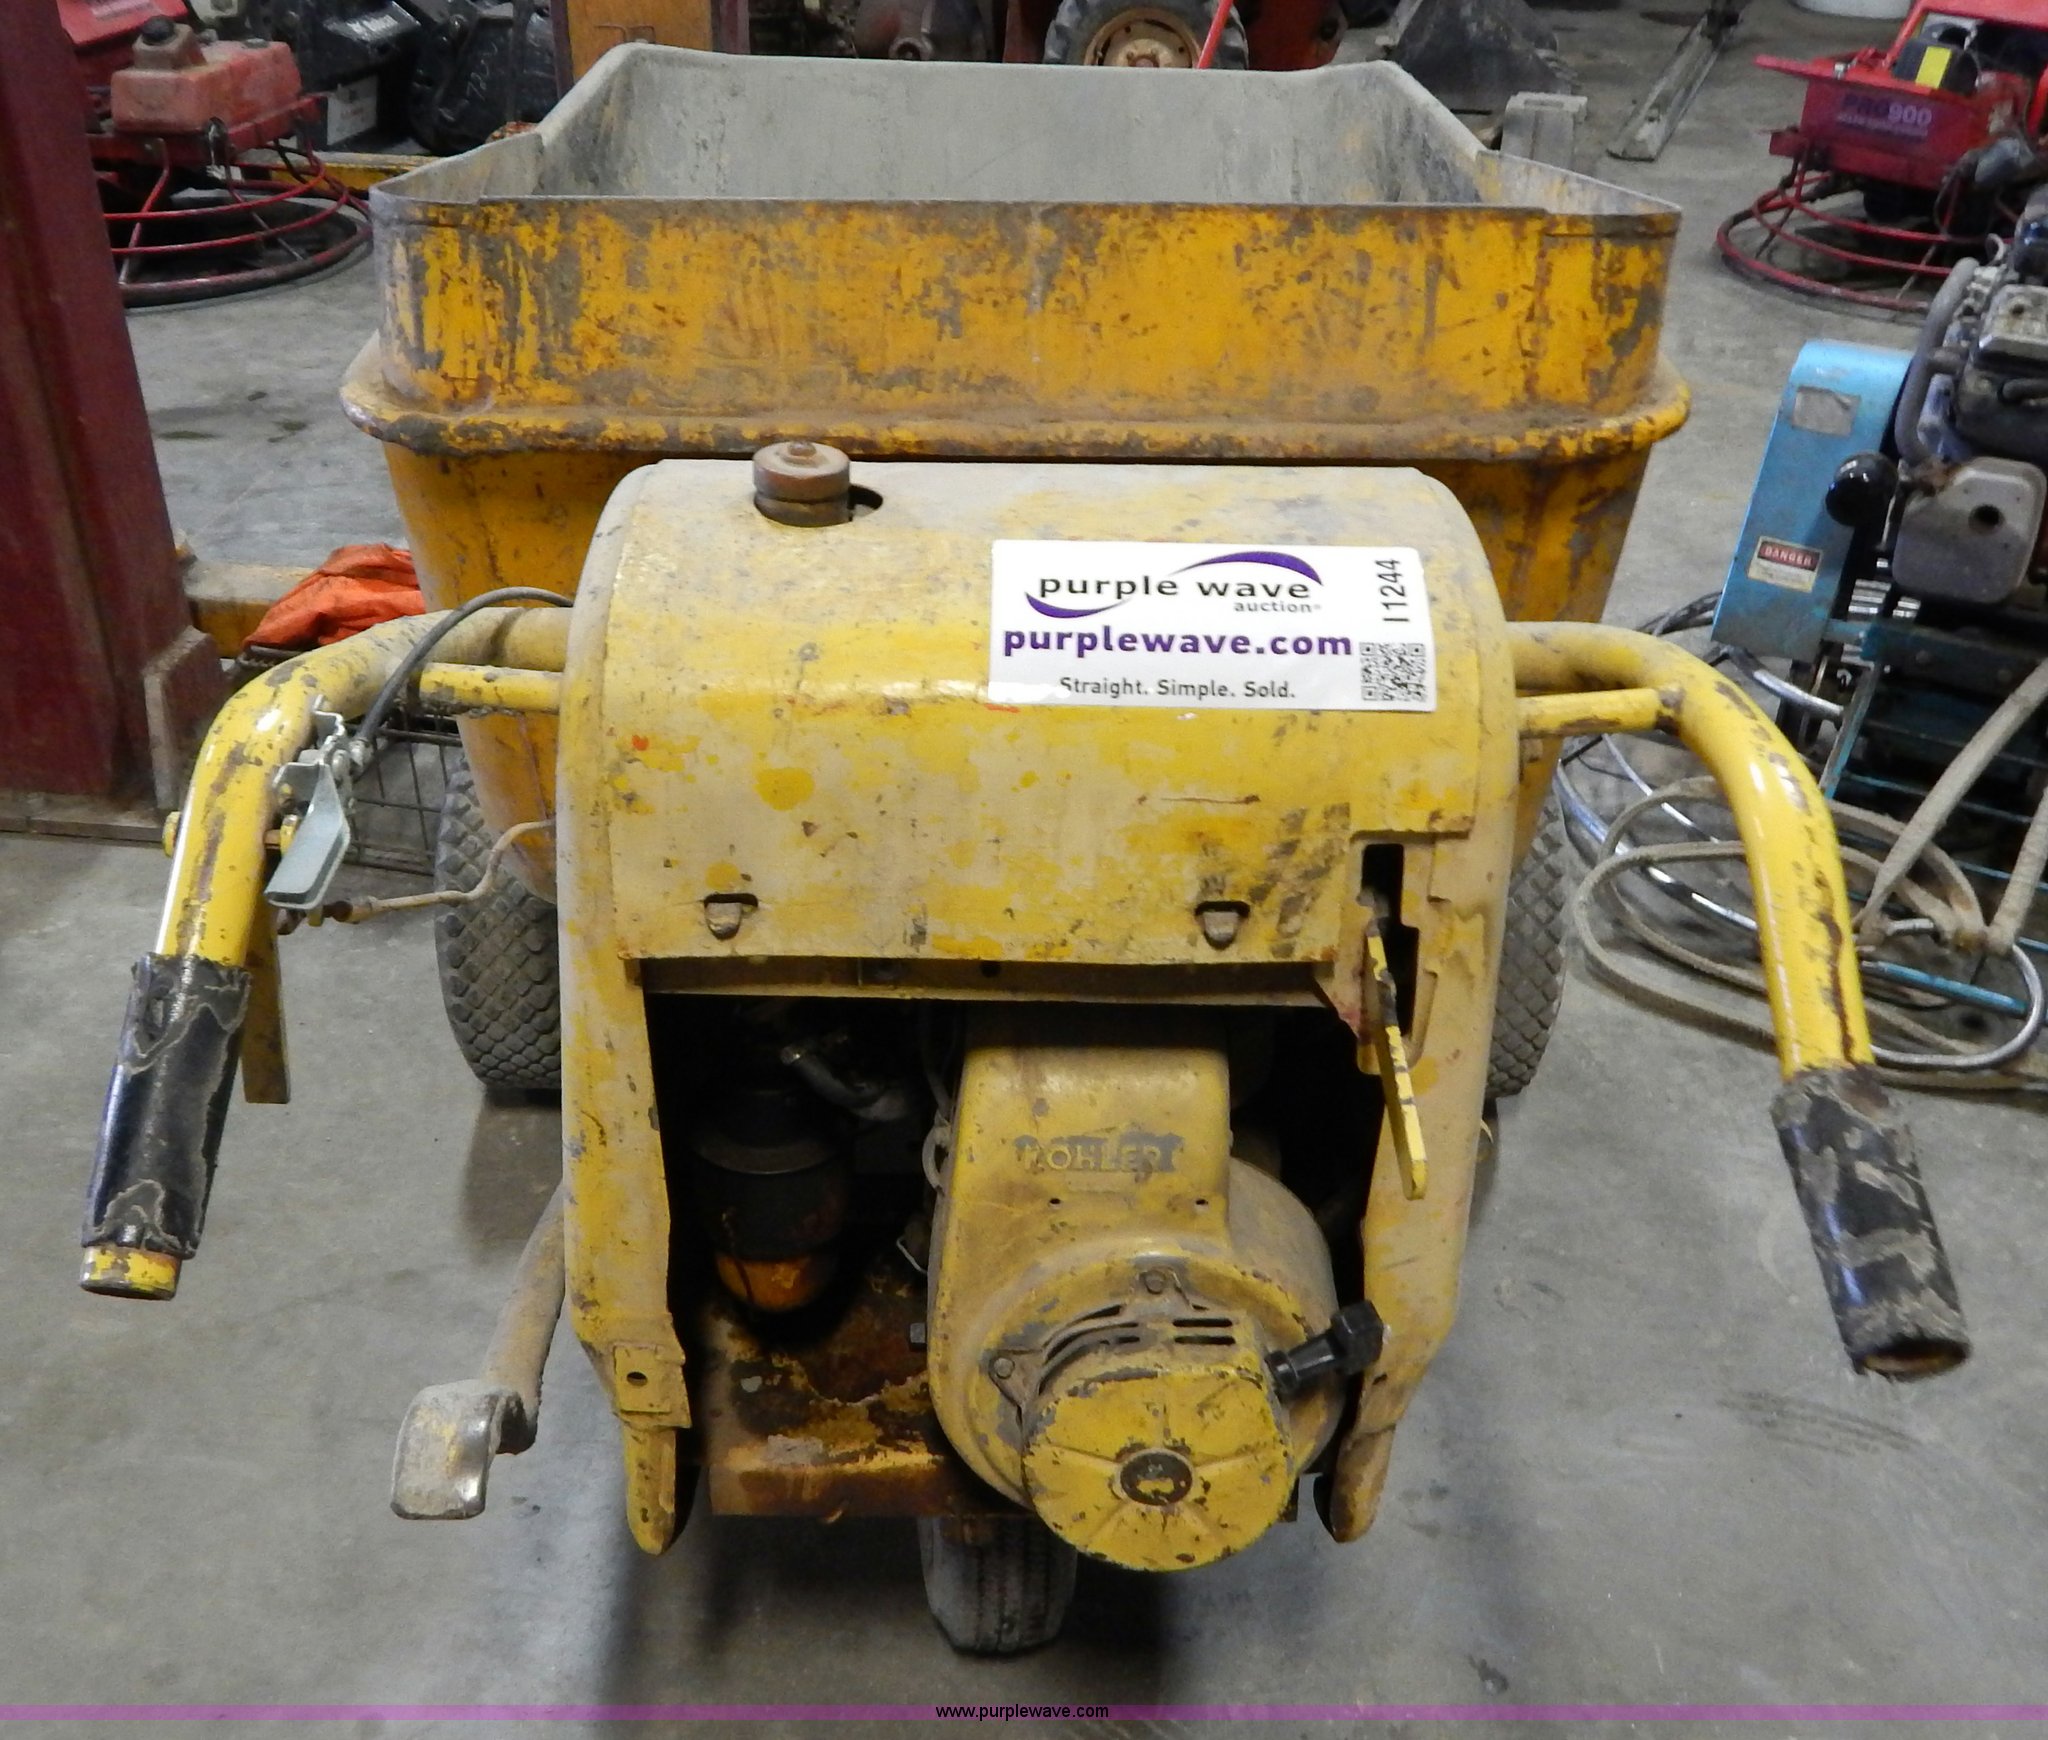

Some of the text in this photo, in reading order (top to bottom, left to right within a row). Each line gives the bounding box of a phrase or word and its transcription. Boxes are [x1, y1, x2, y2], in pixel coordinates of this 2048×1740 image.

[1765, 545, 1812, 566] DANGER
[1040, 576, 1310, 600] purple wave
[1375, 559, 1410, 622] 11244
[1004, 625, 1353, 658] purplewave.com
[1060, 677, 1295, 699] Straight. Simple. Sold.
